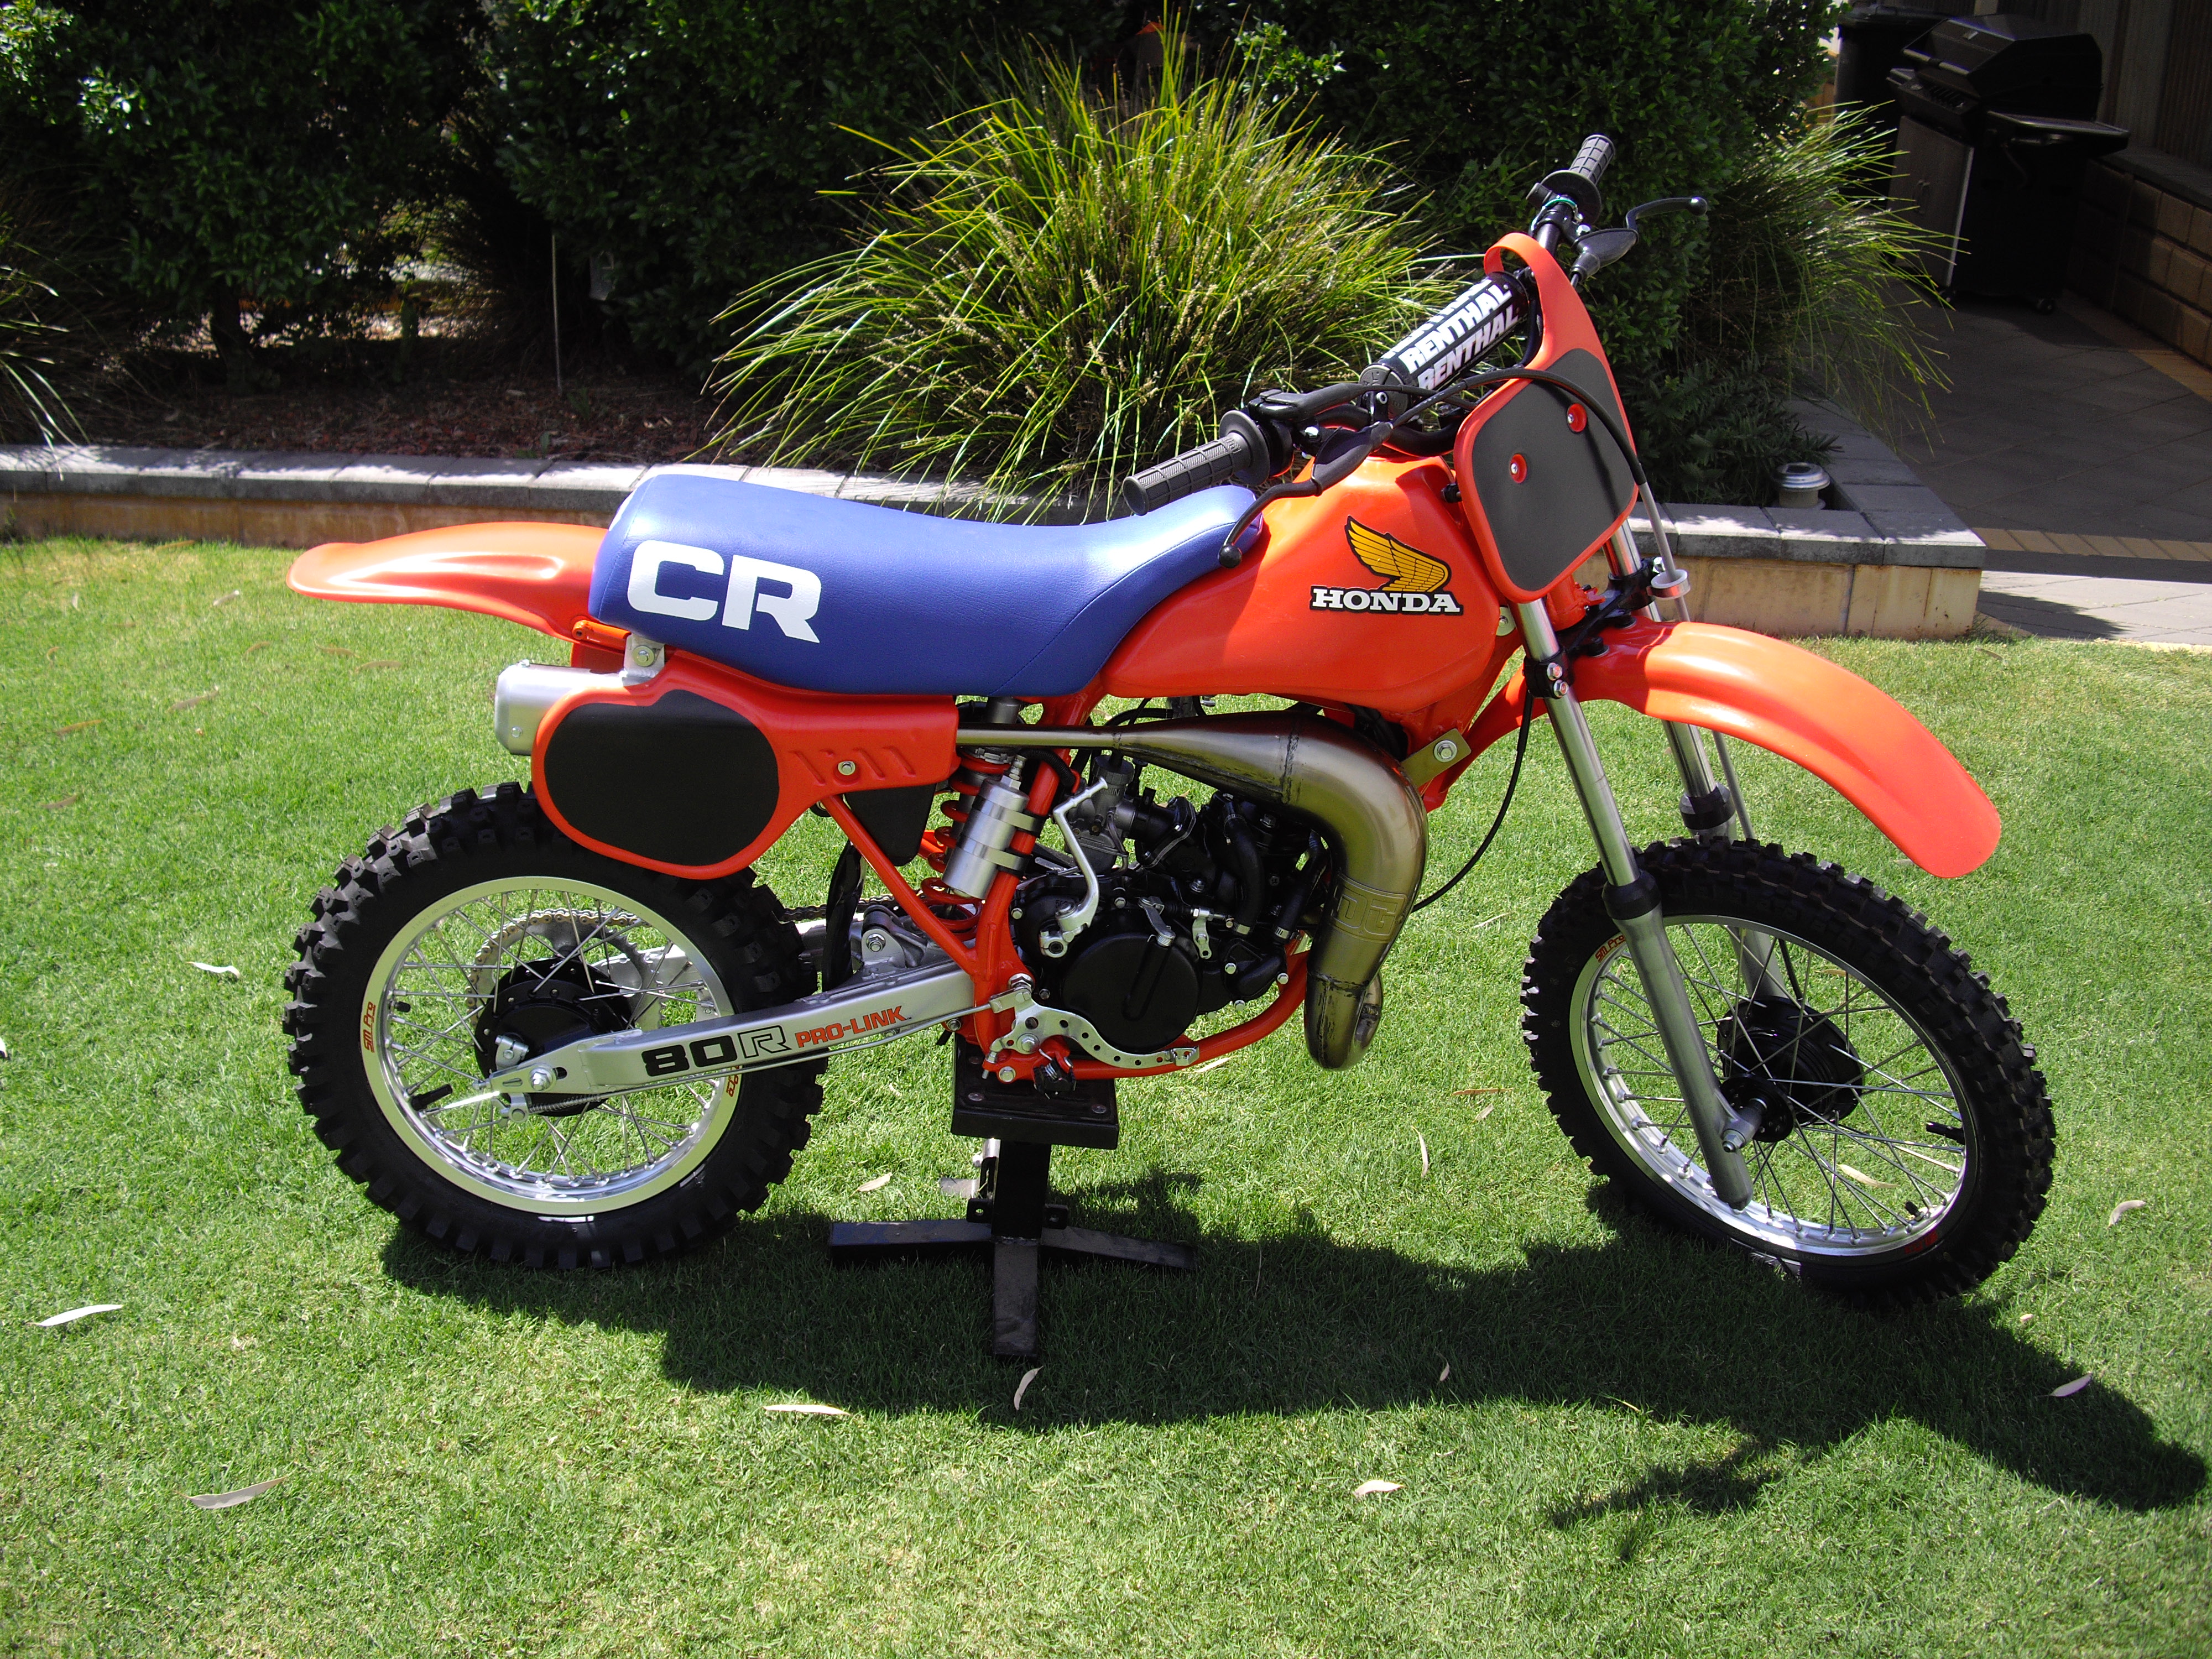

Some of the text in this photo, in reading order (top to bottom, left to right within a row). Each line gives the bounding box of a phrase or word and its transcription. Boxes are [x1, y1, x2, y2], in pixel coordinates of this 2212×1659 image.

[1397, 284, 1512, 374] RENTHAL
[1417, 304, 1519, 390] RENTHAL
[627, 540, 822, 643] CR
[1312, 588, 1460, 613] HONDA
[795, 1005, 907, 1048] PRO-LINK
